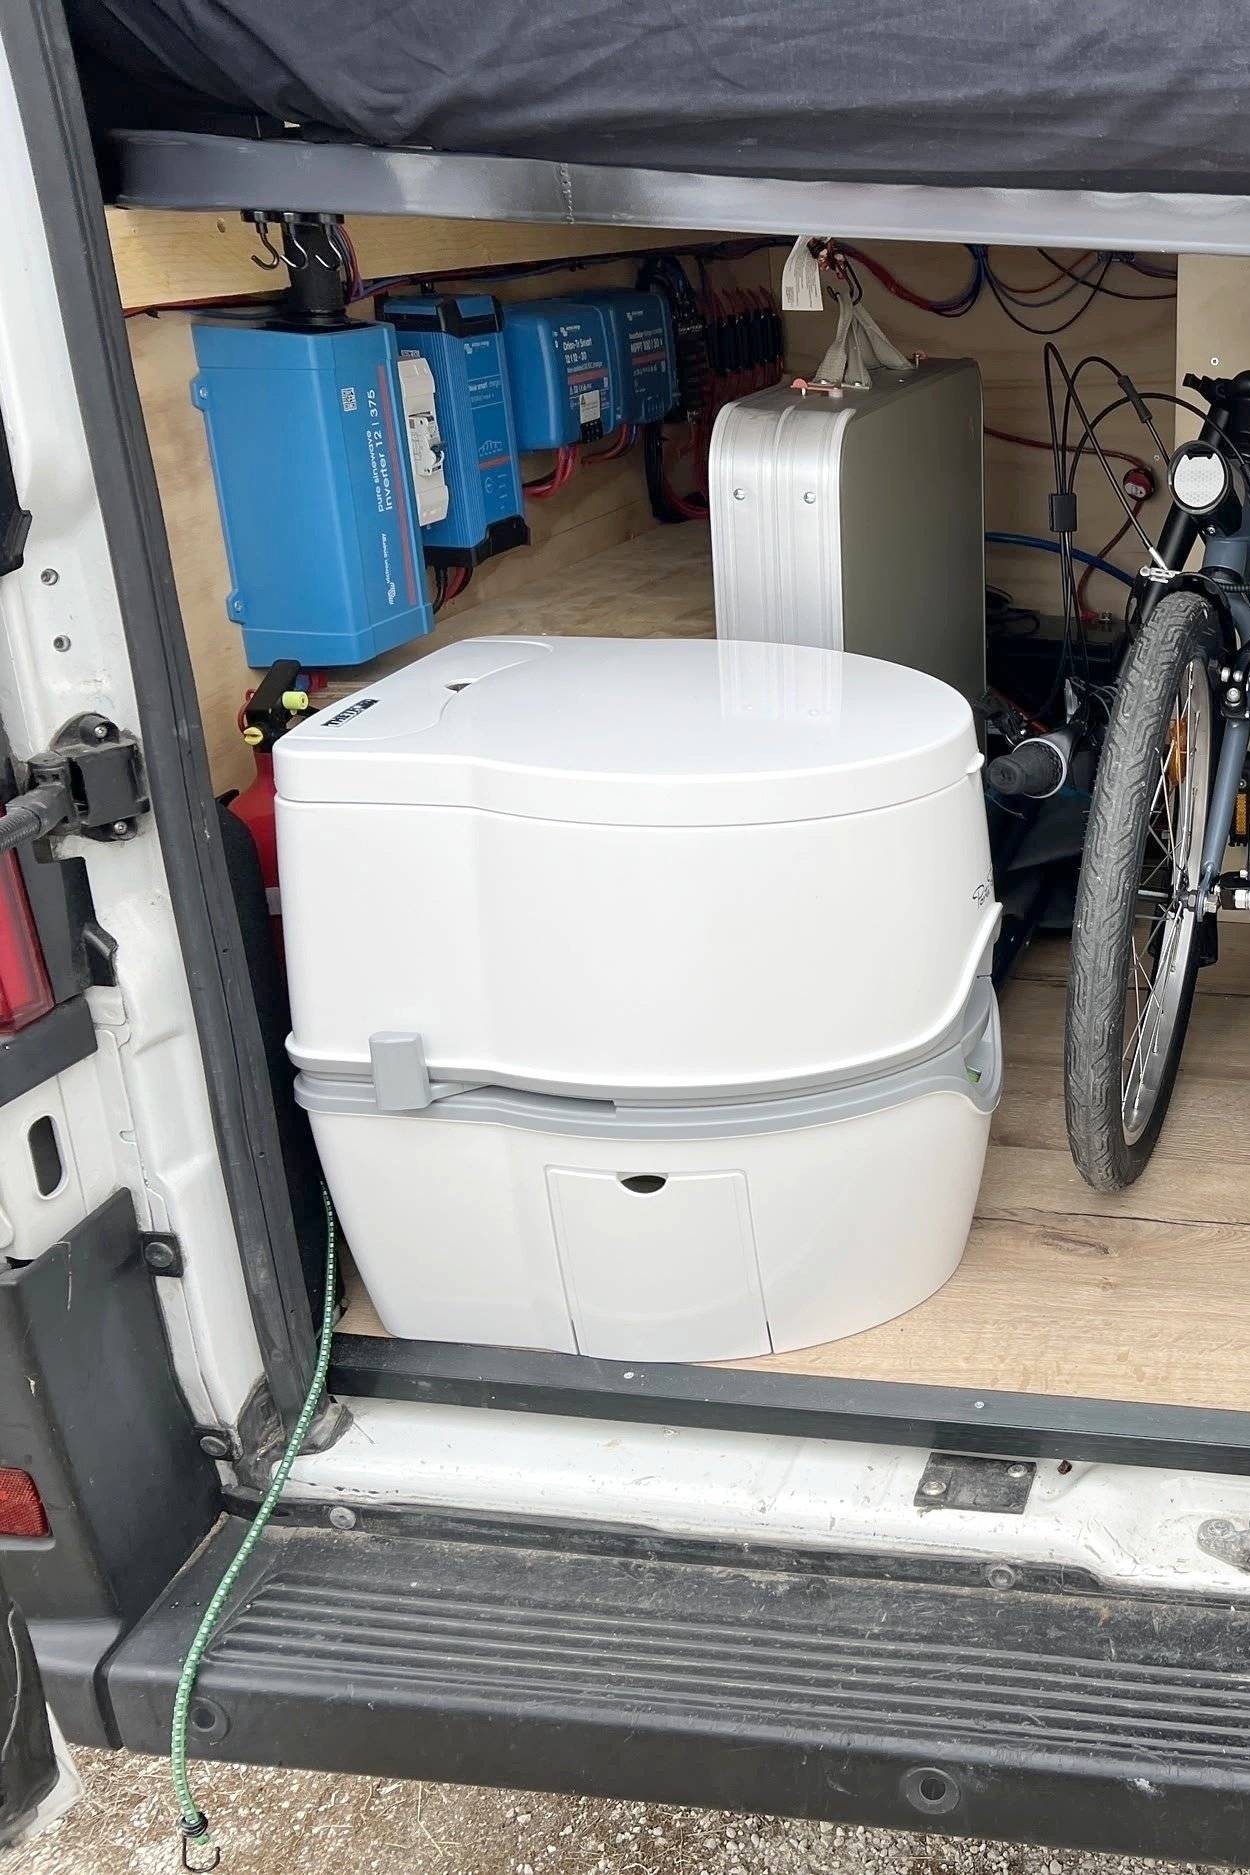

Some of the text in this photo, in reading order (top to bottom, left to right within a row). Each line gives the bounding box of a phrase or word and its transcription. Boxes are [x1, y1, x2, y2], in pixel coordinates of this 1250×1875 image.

[366, 389, 379, 418] 375
[374, 430, 383, 449] 12
[366, 430, 385, 512] pure sinewave
